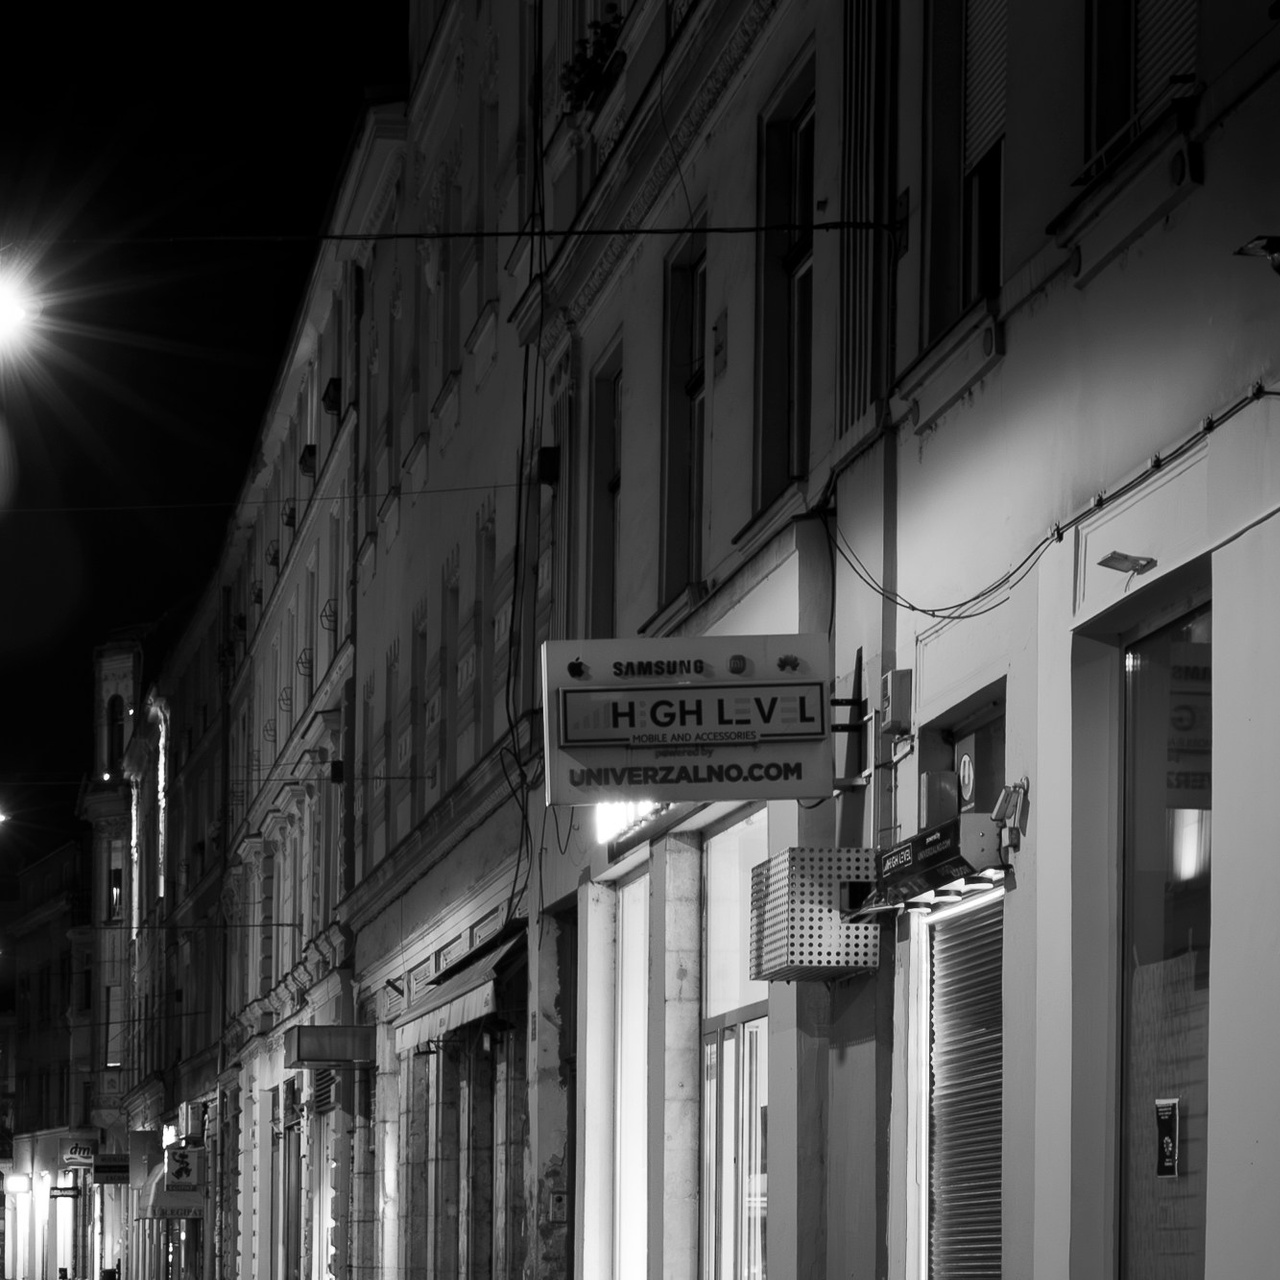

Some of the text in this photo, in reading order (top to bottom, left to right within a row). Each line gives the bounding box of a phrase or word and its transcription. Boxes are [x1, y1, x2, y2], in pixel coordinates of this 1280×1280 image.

[613, 659, 704, 677] SAMSUNG
[632, 731, 757, 743] MOBILE AND ACCESSORIES
[655, 747, 714, 759] powered by
[570, 762, 802, 786] UNIVERZALNO.COM
[70, 1143, 90, 1156] dm
